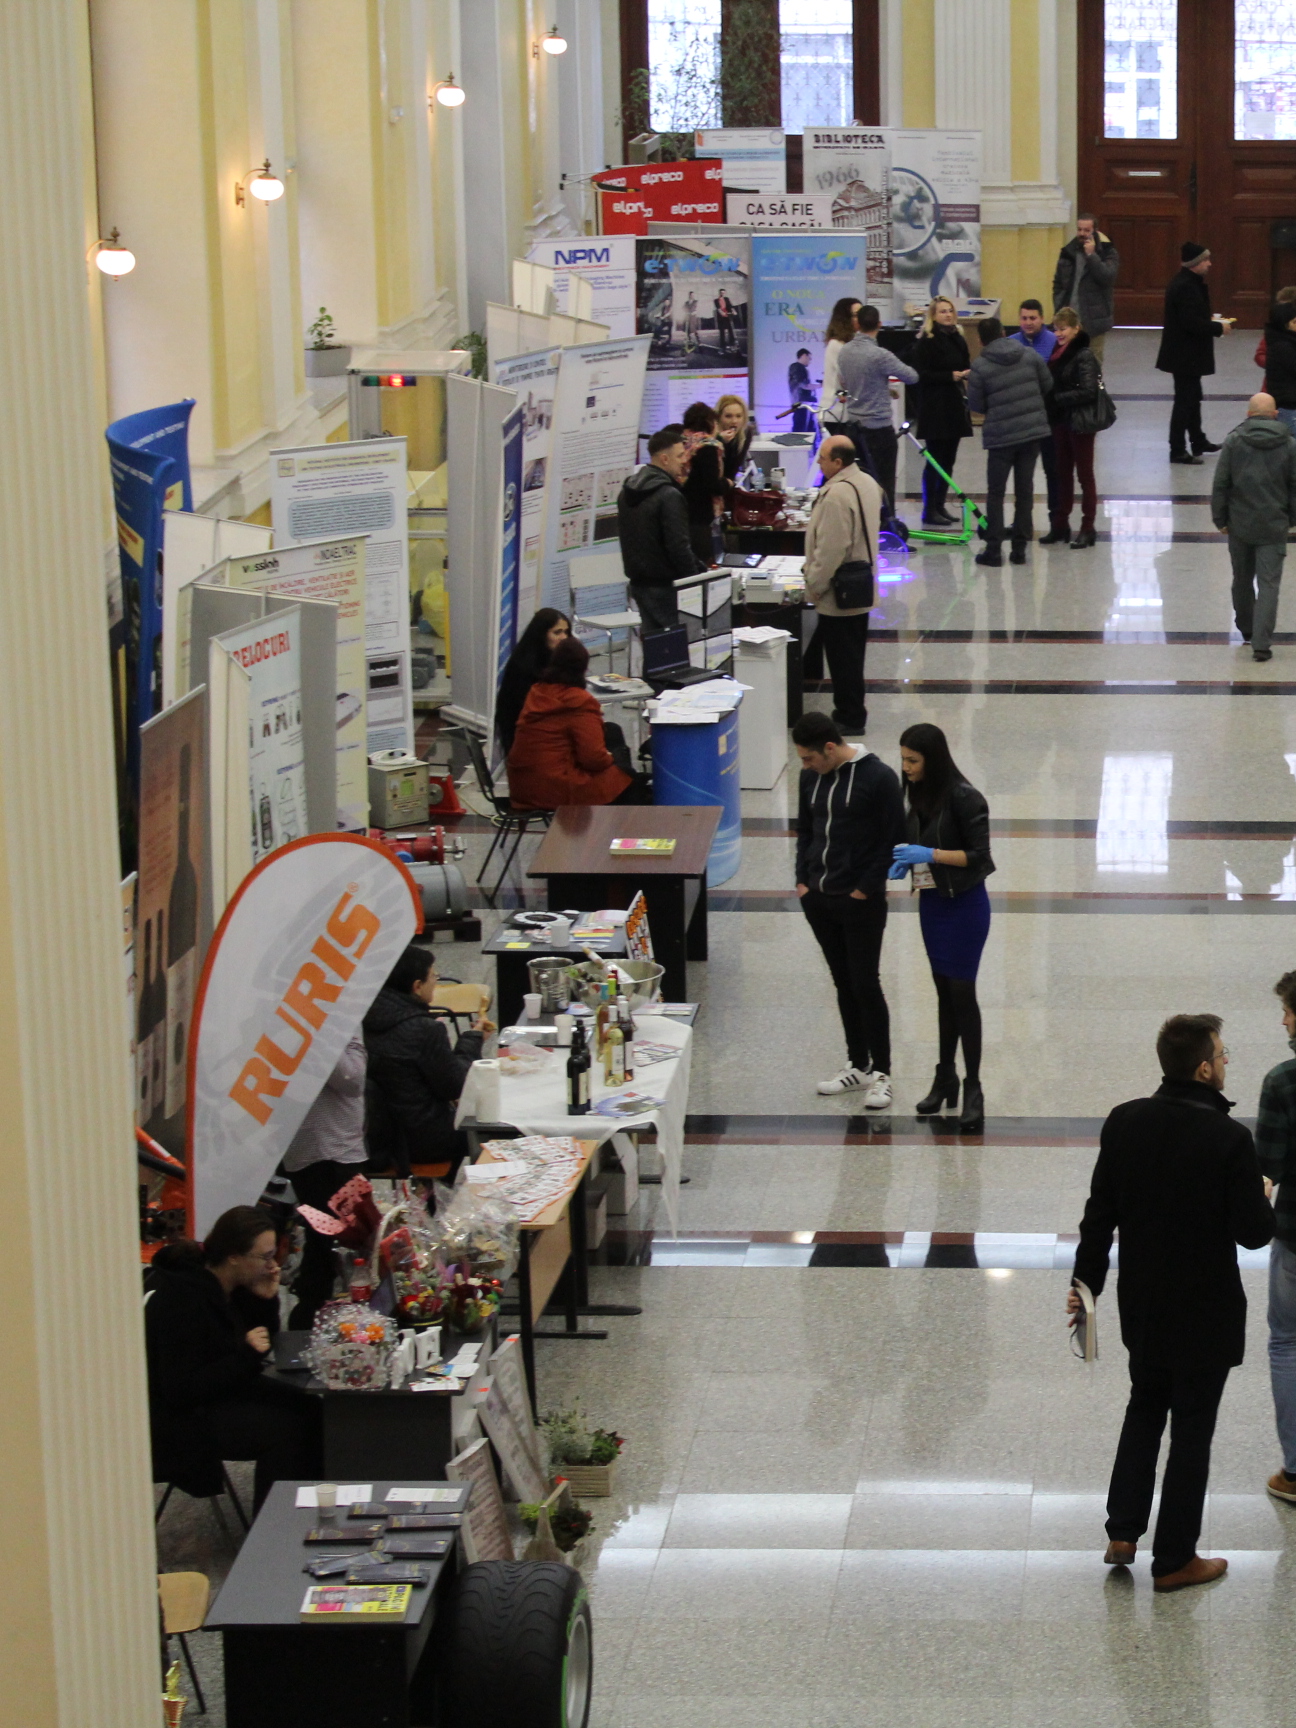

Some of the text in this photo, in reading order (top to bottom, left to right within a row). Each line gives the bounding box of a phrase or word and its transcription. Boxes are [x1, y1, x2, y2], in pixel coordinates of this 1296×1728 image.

[813, 134, 885, 144] BIBLIOTECA
[641, 171, 684, 185] elpreco
[815, 163, 860, 190] 1966
[670, 202, 719, 216] elpreco
[746, 200, 814, 215] CA SĂ FIE
[554, 248, 610, 265] NPM
[764, 302, 805, 316] ERA
[228, 890, 381, 1127] RURIS
